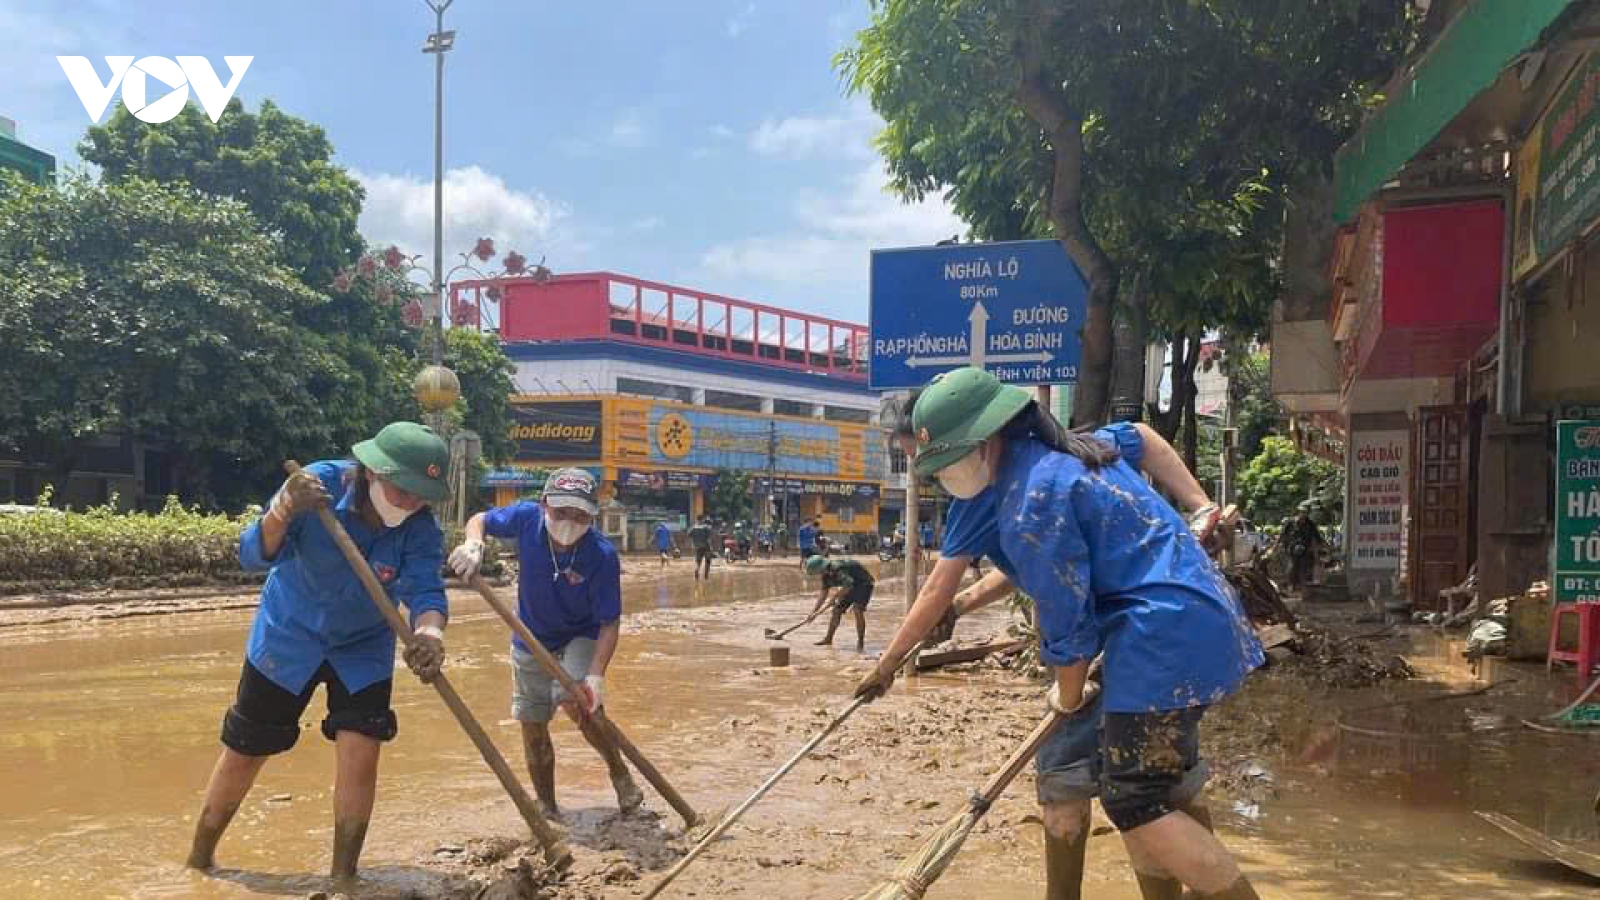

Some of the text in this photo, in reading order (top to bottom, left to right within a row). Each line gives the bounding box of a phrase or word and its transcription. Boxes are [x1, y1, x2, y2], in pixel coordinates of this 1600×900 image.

[945, 257, 1019, 280] NGHĨA LỘ
[1013, 303, 1068, 325] ĐƯỜNG
[1024, 327, 1062, 349] BÌNH
[1023, 365, 1051, 380] VIỆN
[1055, 365, 1076, 378] 103
